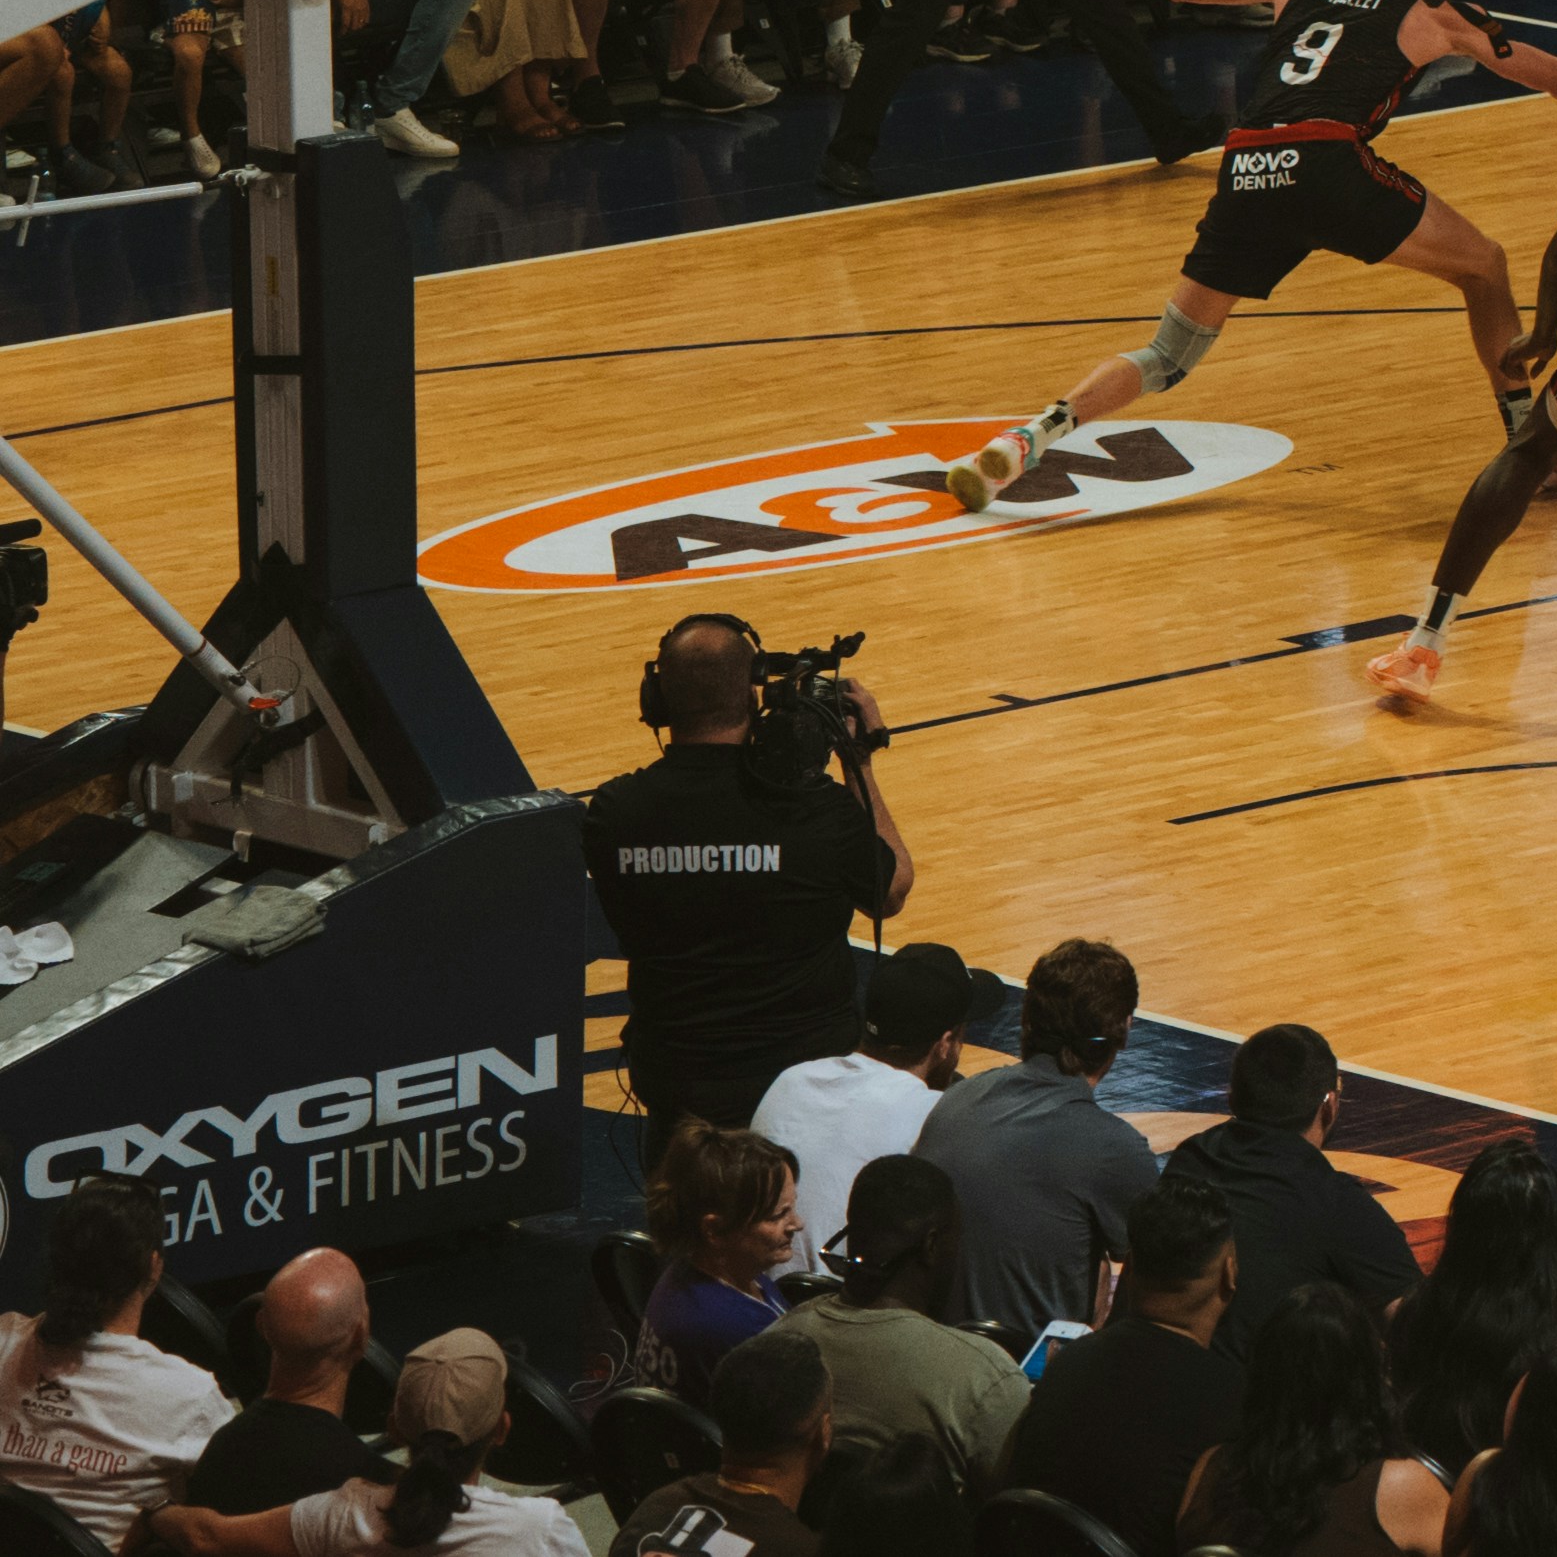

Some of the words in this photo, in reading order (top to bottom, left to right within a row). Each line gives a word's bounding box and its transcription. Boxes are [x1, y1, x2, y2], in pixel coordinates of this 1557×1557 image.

[1279, 21, 1345, 86] 9
[1231, 148, 1300, 176] NOVO
[1232, 166, 1298, 192] DENTAL
[618, 844, 781, 875] PRODUCTION
[23, 1032, 559, 1200] OXYGEN
[243, 1165, 285, 1228] &
[307, 1109, 528, 1214] FITNESS
[5, 1422, 49, 1459] than
[52, 1442, 64, 1464] a
[69, 1442, 129, 1478] game
